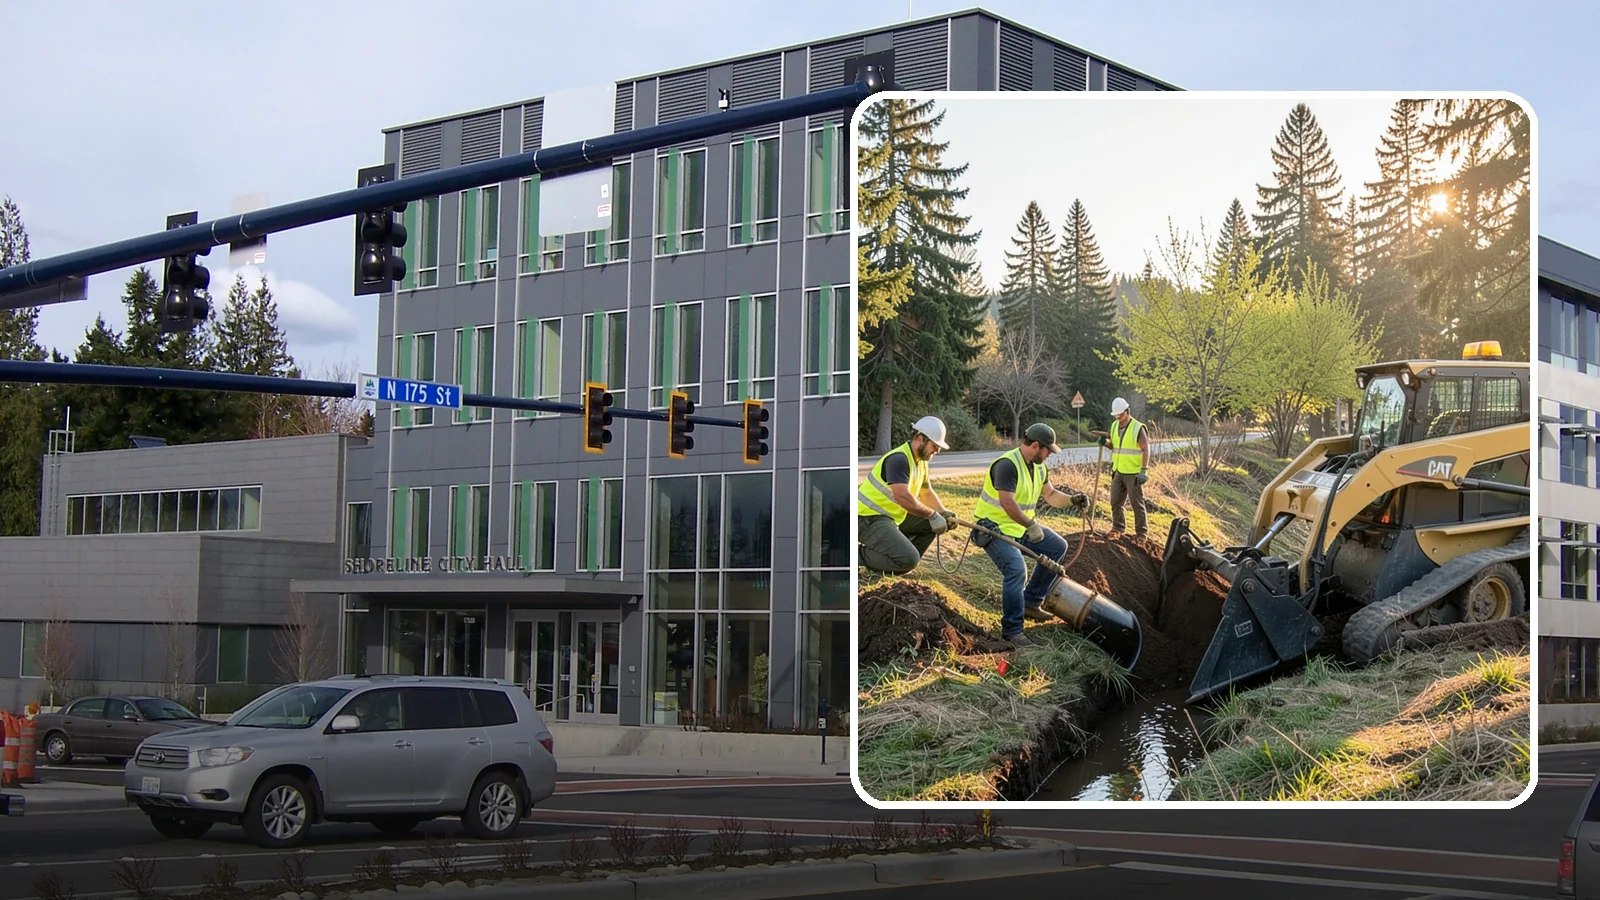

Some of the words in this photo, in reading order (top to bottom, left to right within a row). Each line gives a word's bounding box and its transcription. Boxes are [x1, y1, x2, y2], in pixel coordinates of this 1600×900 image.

[387, 380, 396, 400] N
[405, 382, 427, 403] 175
[436, 386, 451, 406] St
[1428, 460, 1452, 480] CAT
[344, 557, 432, 574] SHORELINE
[438, 556, 475, 572] CITY
[484, 555, 525, 571] HALL
